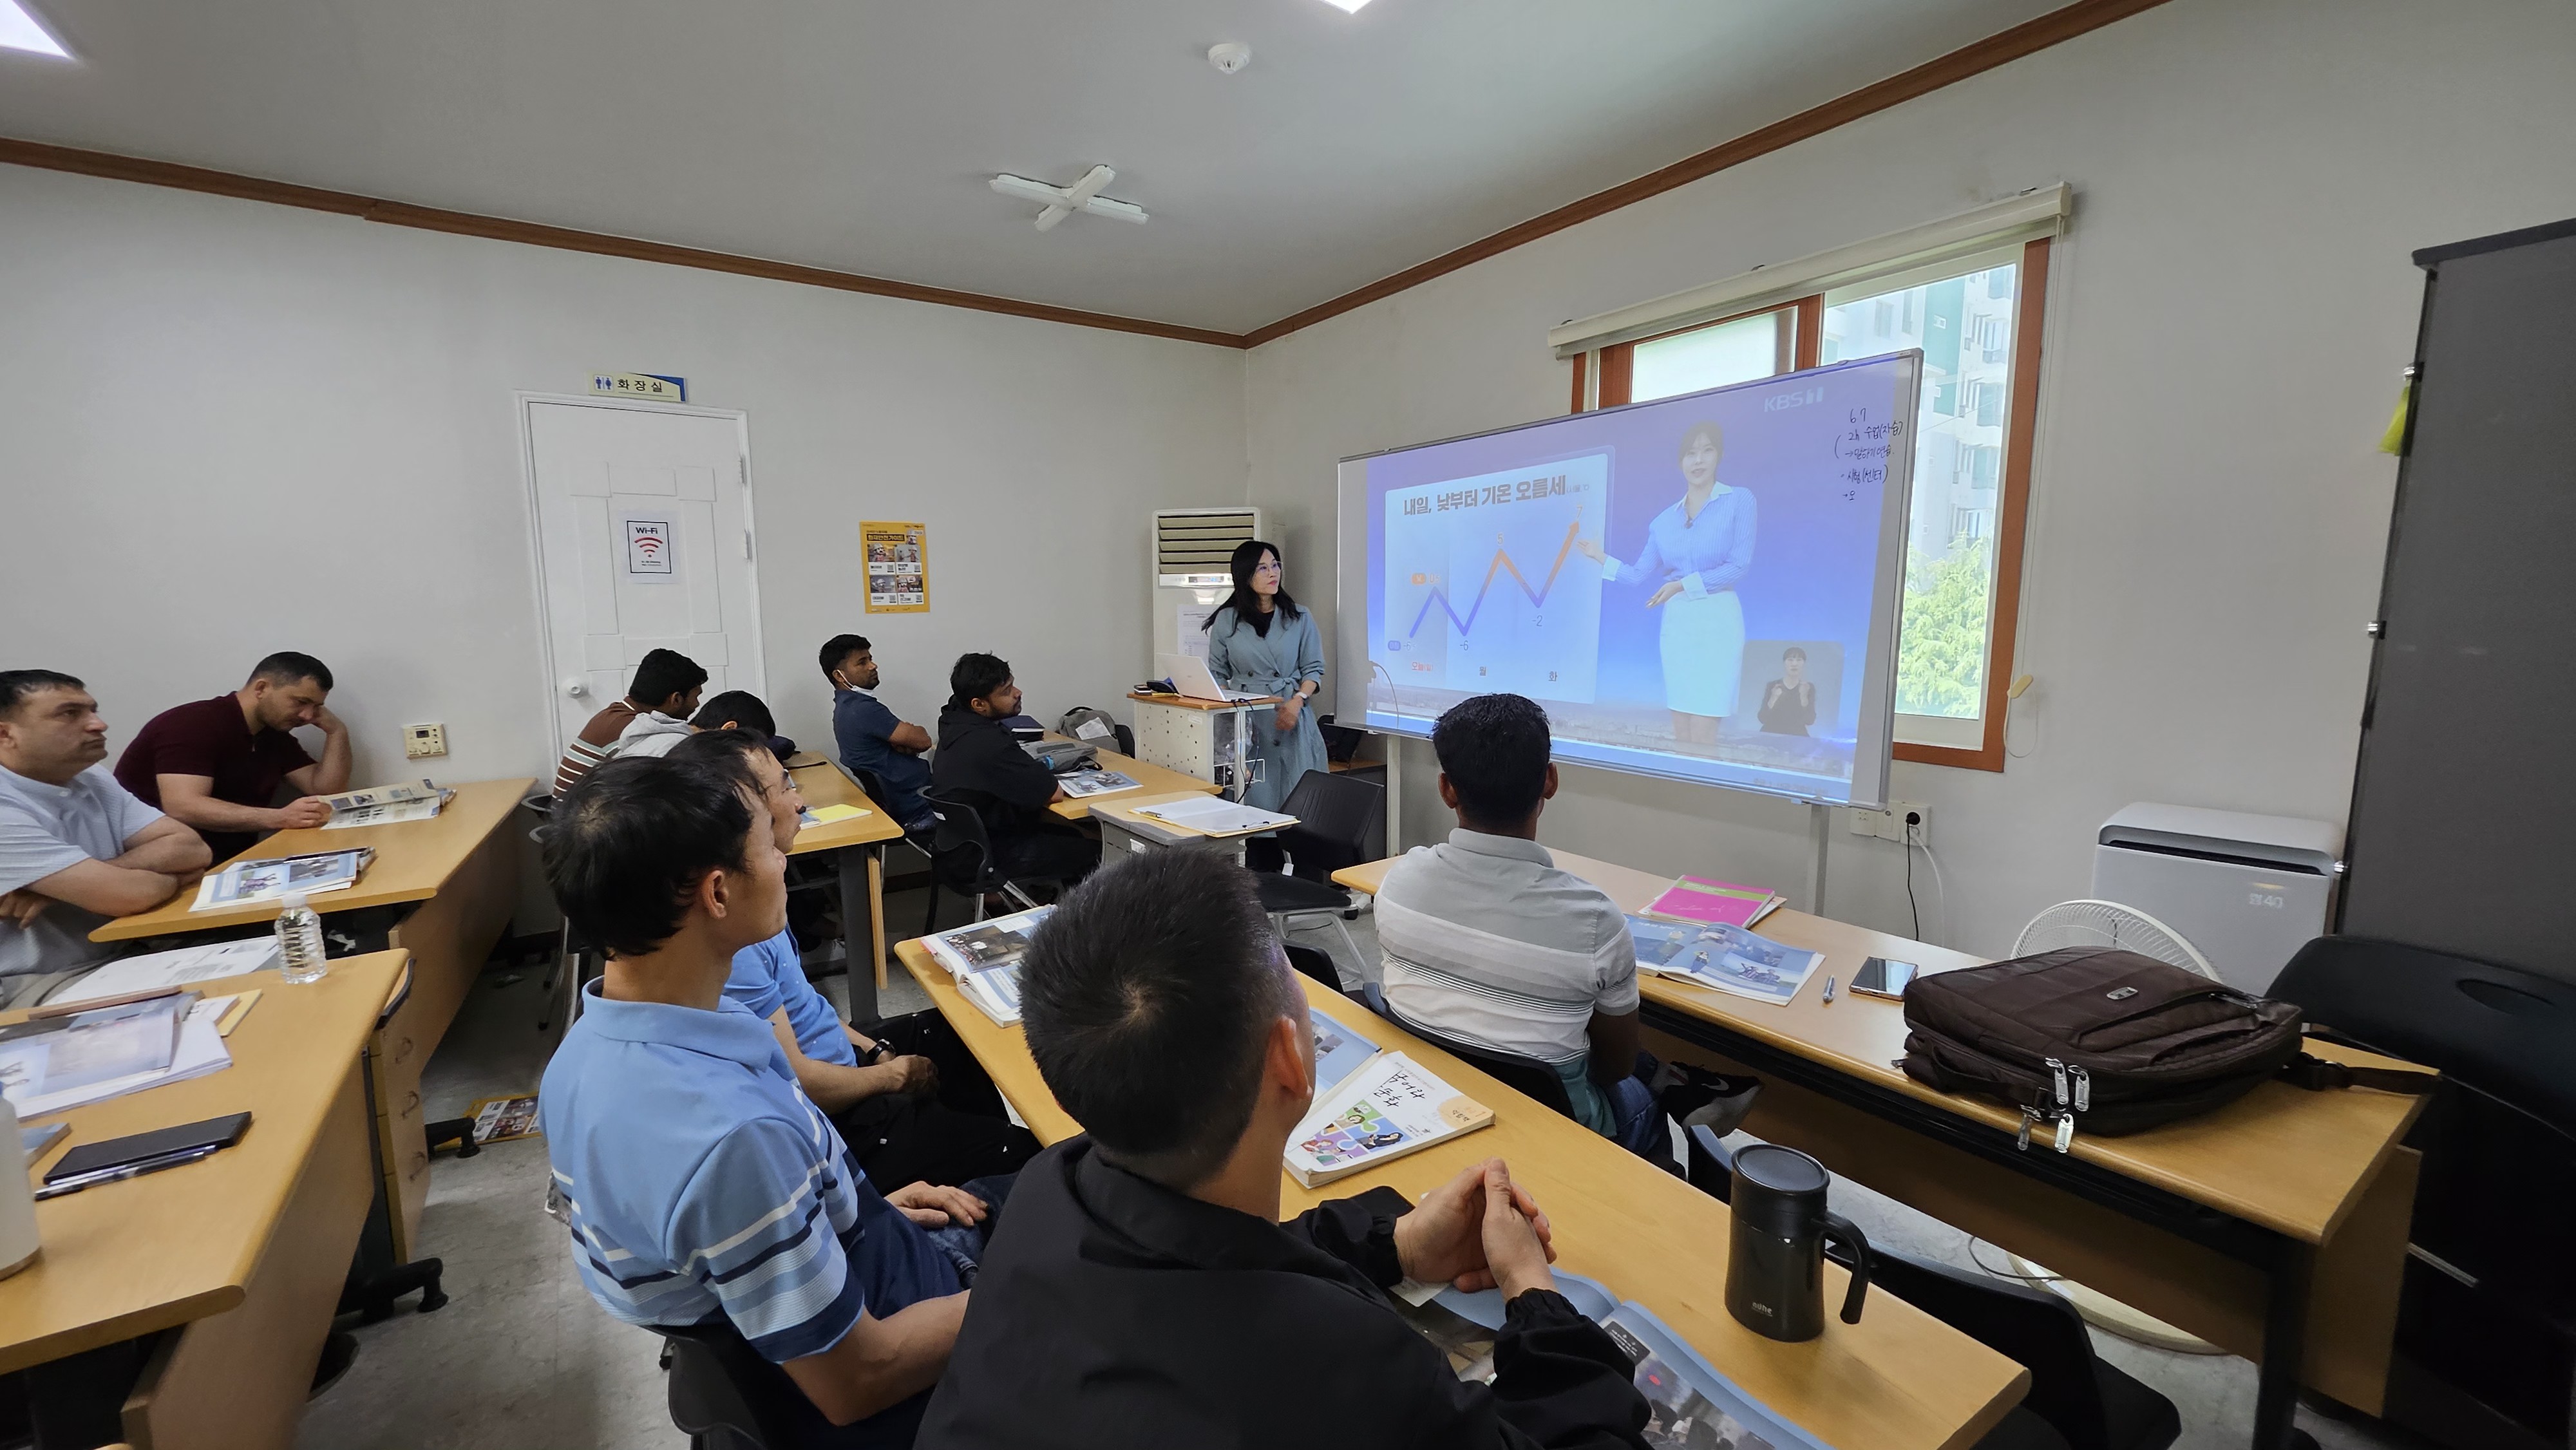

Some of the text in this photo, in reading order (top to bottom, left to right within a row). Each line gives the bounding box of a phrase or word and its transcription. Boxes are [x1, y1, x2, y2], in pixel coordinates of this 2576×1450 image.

[617, 378, 663, 393] 화장실
[1404, 496, 1432, 516] 내일,
[1437, 489, 1478, 512] 낮부터
[1482, 484, 1511, 505] 기온
[1516, 475, 1566, 501] 오름세
[1497, 533, 1504, 545] 5
[1531, 615, 1543, 628] -2
[1459, 640, 1469, 651] -6
